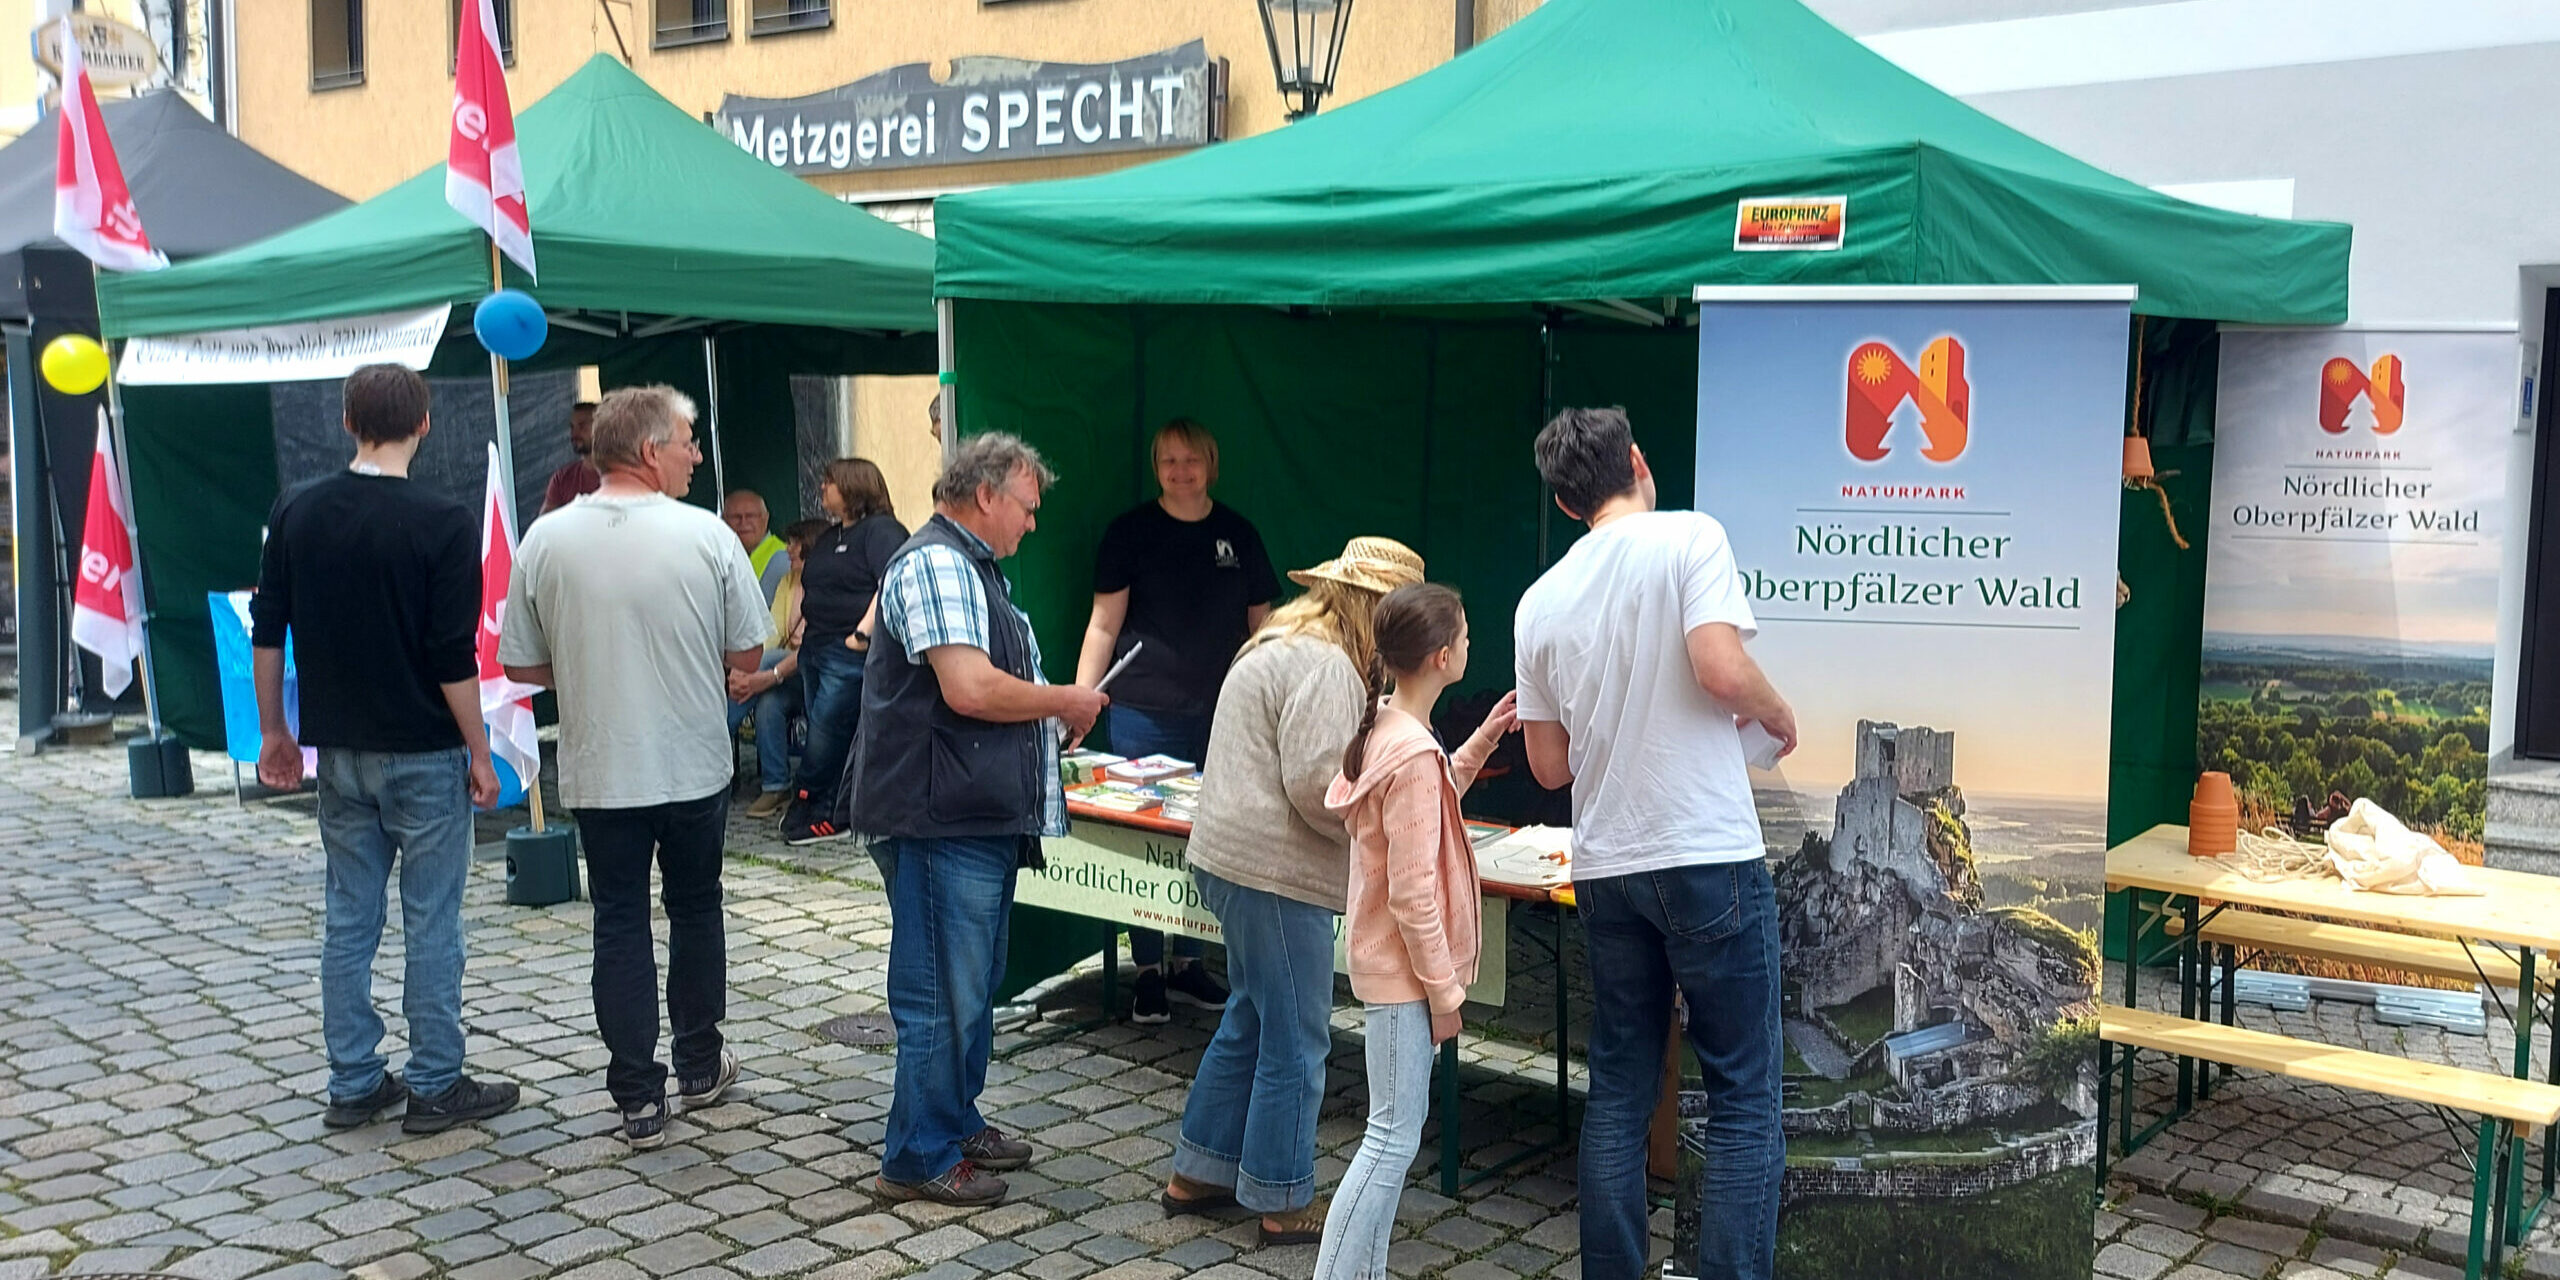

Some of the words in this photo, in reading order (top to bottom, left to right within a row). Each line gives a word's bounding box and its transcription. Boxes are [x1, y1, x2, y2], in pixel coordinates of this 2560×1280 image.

[52, 40, 145, 71] KMBACHER
[733, 98, 936, 169] Metzgerei
[961, 75, 1184, 154] SPECHT
[1752, 205, 1830, 223] EUROPRINZ
[2316, 450, 2401, 461] NATURPARK
[1842, 484, 1965, 499] NATURPARK
[2284, 474, 2432, 498] Nördlicher
[2233, 504, 2399, 534] Oberpfälzer
[2408, 509, 2479, 532] Wald
[1796, 523, 2011, 559] Nördlicher
[1975, 576, 2082, 609] Wald
